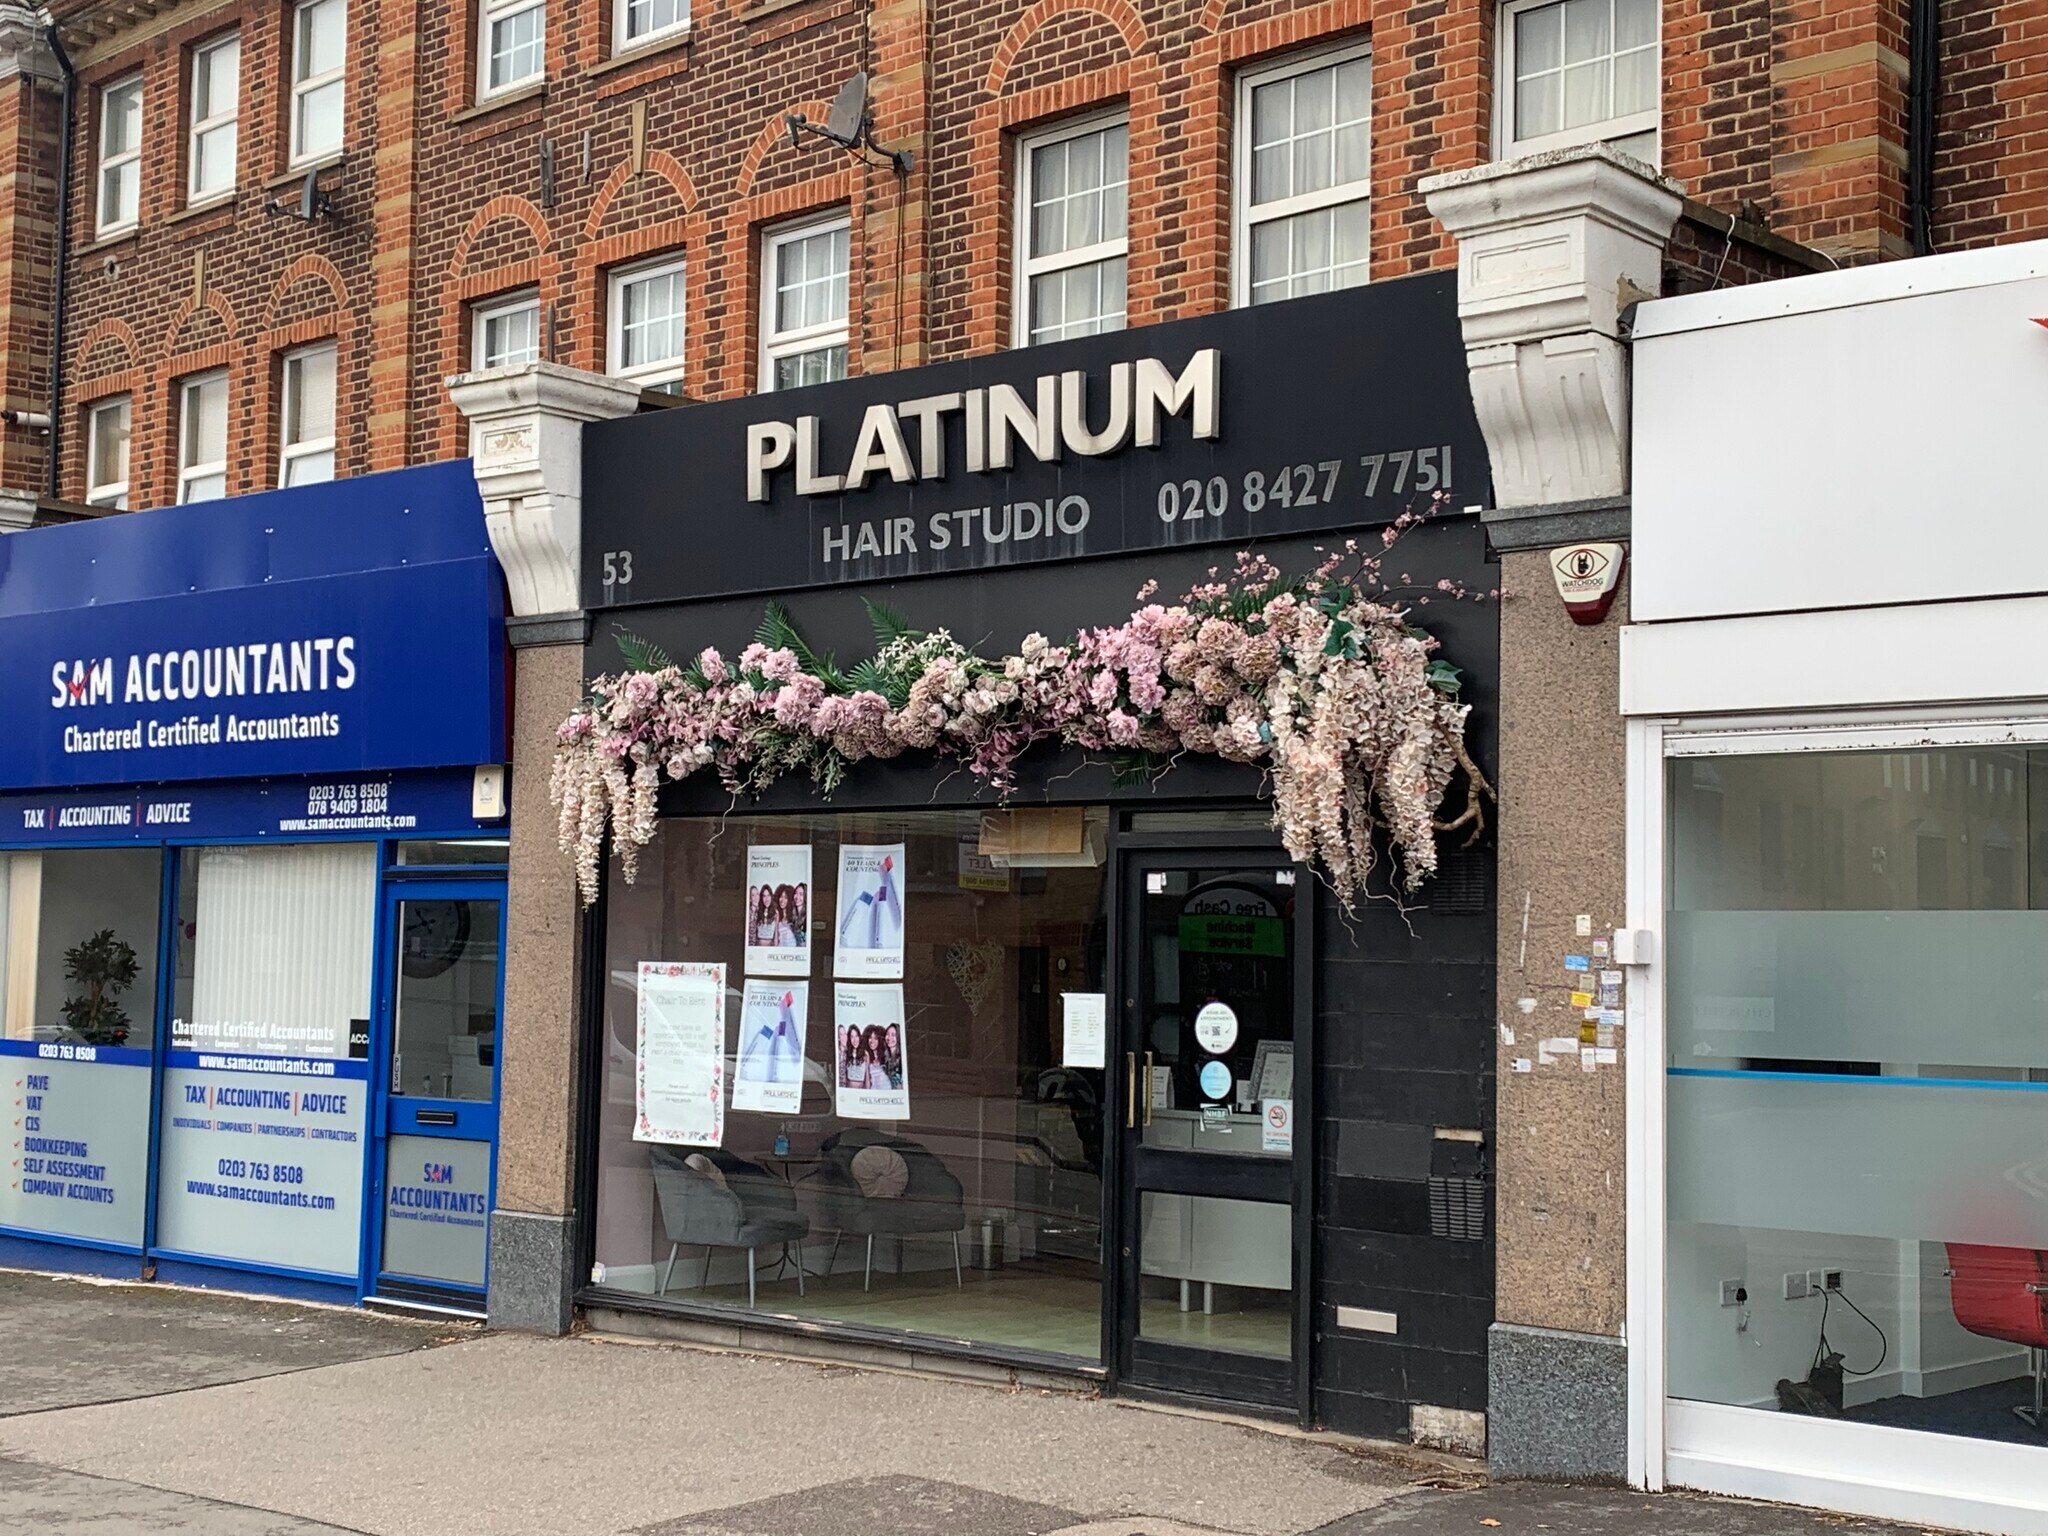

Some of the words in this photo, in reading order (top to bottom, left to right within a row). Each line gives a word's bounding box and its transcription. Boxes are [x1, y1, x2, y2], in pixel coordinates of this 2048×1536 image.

[747, 348, 1221, 502] PLATINUM
[1157, 475, 1229, 523] 020
[1242, 459, 1342, 512] 8427
[1360, 445, 1452, 498] 7751
[822, 516, 918, 563] HAIR
[929, 495, 1091, 551] STUDIO
[602, 550, 633, 586] 53
[1562, 577, 1604, 588] WATCHDOG
[51, 656, 114, 708] SAM
[124, 636, 356, 703] ACCOUNTANTS
[64, 720, 142, 753] Chartered
[148, 714, 220, 748] Certified
[226, 711, 340, 743] Accountants
[308, 785, 335, 801] 0203
[337, 784, 357, 799] 763
[359, 782, 388, 798] 8508
[23, 808, 46, 829] TAX
[58, 804, 131, 828] ACCOUNTING
[145, 801, 192, 825] ADVICE
[307, 800, 327, 816] 078
[329, 799, 357, 815] 9409
[360, 797, 388, 814] 1804
[279, 813, 417, 832] www.samaccountants.com
[172, 1018, 220, 1037] Chartered
[222, 1020, 266, 1039] Certified
[269, 1023, 334, 1042] Accountants
[38, 1043, 59, 1058] 0203
[59, 1045, 74, 1060] 763
[75, 1047, 97, 1062] 8508
[199, 1054, 335, 1076] www.samaccountants.com
[26, 1075, 49, 1091] PAYE
[26, 1095, 43, 1112] VAT
[185, 1085, 206, 1105] TAX
[216, 1087, 291, 1111] ACCOUNTING
[301, 1093, 347, 1115] ADVICE
[25, 1115, 41, 1131] CIS
[173, 1117, 212, 1130] INDIVIDUALS
[216, 1120, 253, 1134] COMPANIES
[257, 1124, 306, 1139] PARTNERSHIPS
[311, 1128, 358, 1143] CONTRACTORS
[24, 1136, 88, 1158] BOOKKEEPING
[23, 1157, 44, 1173] SELF
[46, 1159, 106, 1182] ASSESSMENT
[218, 1158, 246, 1179] 0203
[249, 1161, 270, 1181] 763
[273, 1165, 304, 1185] 8508
[423, 1162, 453, 1184] SAM
[22, 1178, 65, 1197] COMPANY
[66, 1182, 114, 1204] ACCOUNTS
[186, 1179, 336, 1211] www.samaccountants.com
[390, 1186, 486, 1215] ACCOUNTANTS
